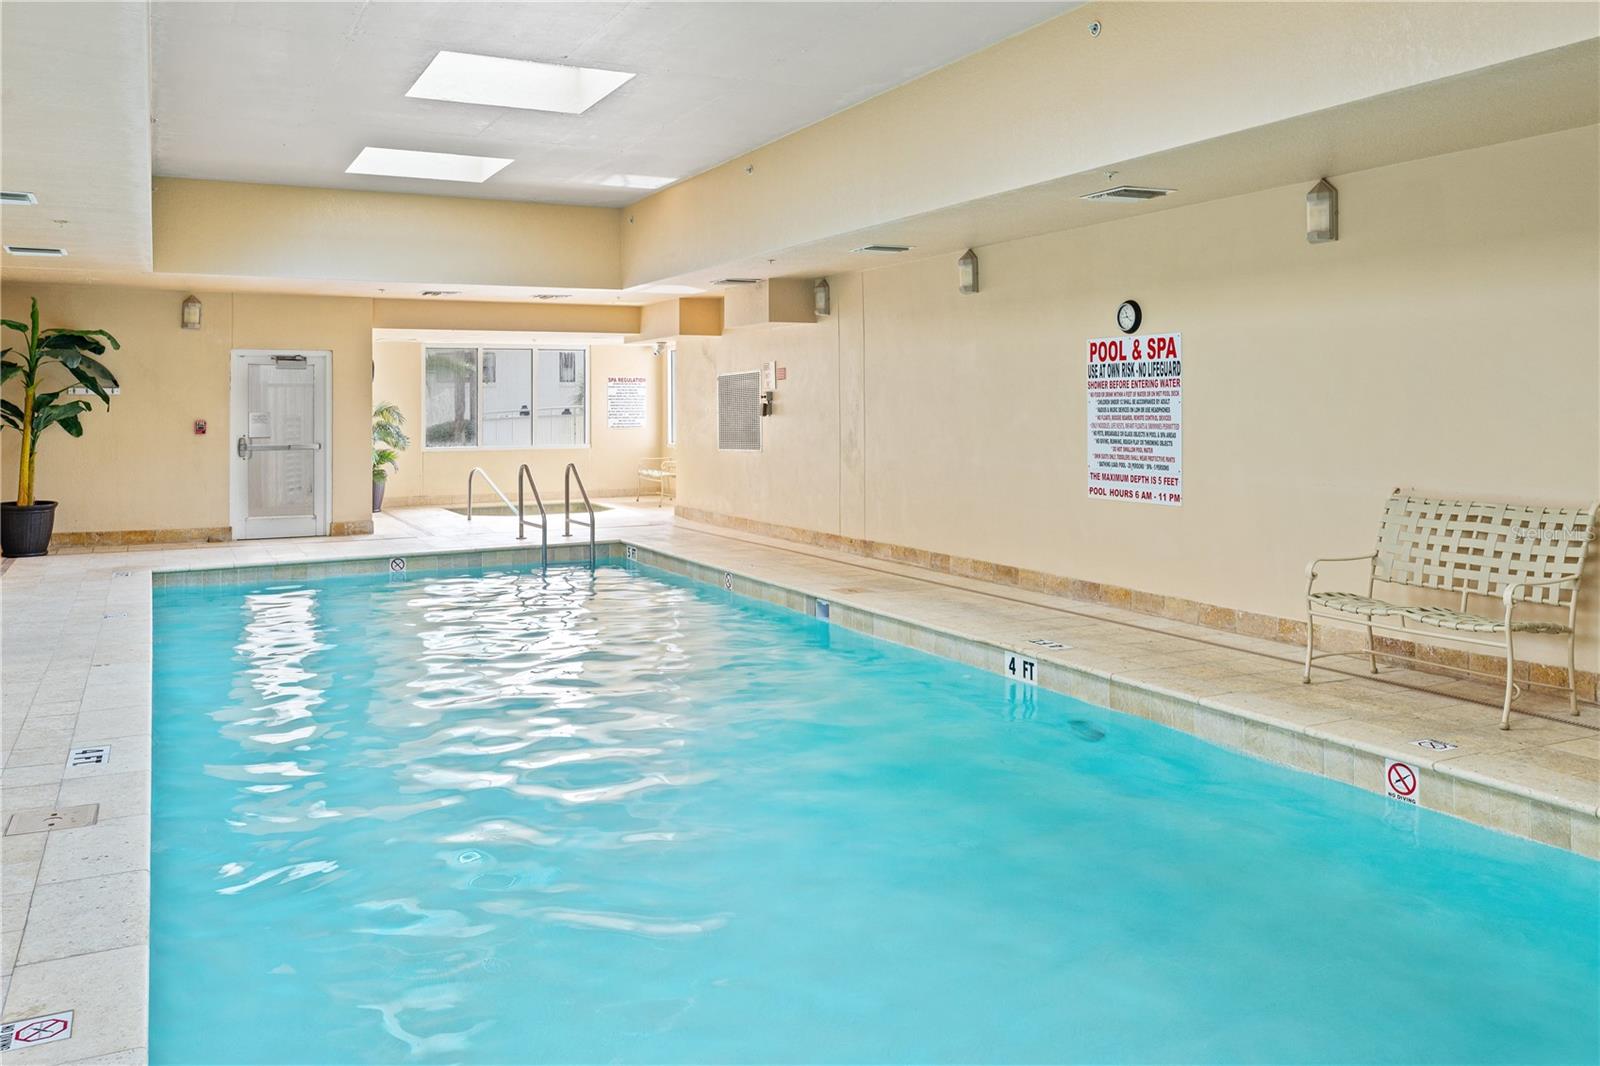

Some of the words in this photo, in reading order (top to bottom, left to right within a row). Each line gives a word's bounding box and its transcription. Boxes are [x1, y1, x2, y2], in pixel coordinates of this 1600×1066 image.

[1090, 340, 1127, 362] POOL
[1132, 340, 1142, 360] &
[1147, 337, 1177, 359] SPA
[1088, 364, 1098, 378] USE
[1099, 364, 1106, 378] AT
[1108, 363, 1120, 378] OWN
[1122, 362, 1135, 377] RISK
[1148, 361, 1181, 377] LIFEGUARD
[1088, 381, 1108, 389] SHOWER
[1110, 380, 1129, 389] BEFORE
[1131, 379, 1158, 388] ENTERING
[1160, 378, 1180, 387] WATER
[1102, 473, 1129, 482] MAXIMUM
[1130, 475, 1149, 483] DEPTH
[1164, 477, 1178, 486] FEET
[1089, 487, 1106, 496] POOL
[1110, 488, 1133, 498] HOURS
[1141, 491, 1152, 500] AM
[1158, 493, 1166, 501] 11
[1169, 494, 1180, 502] PM
[1009, 657, 1016, 675] 4
[1023, 660, 1034, 680] FT
[1397, 795, 1416, 804] DIVING
